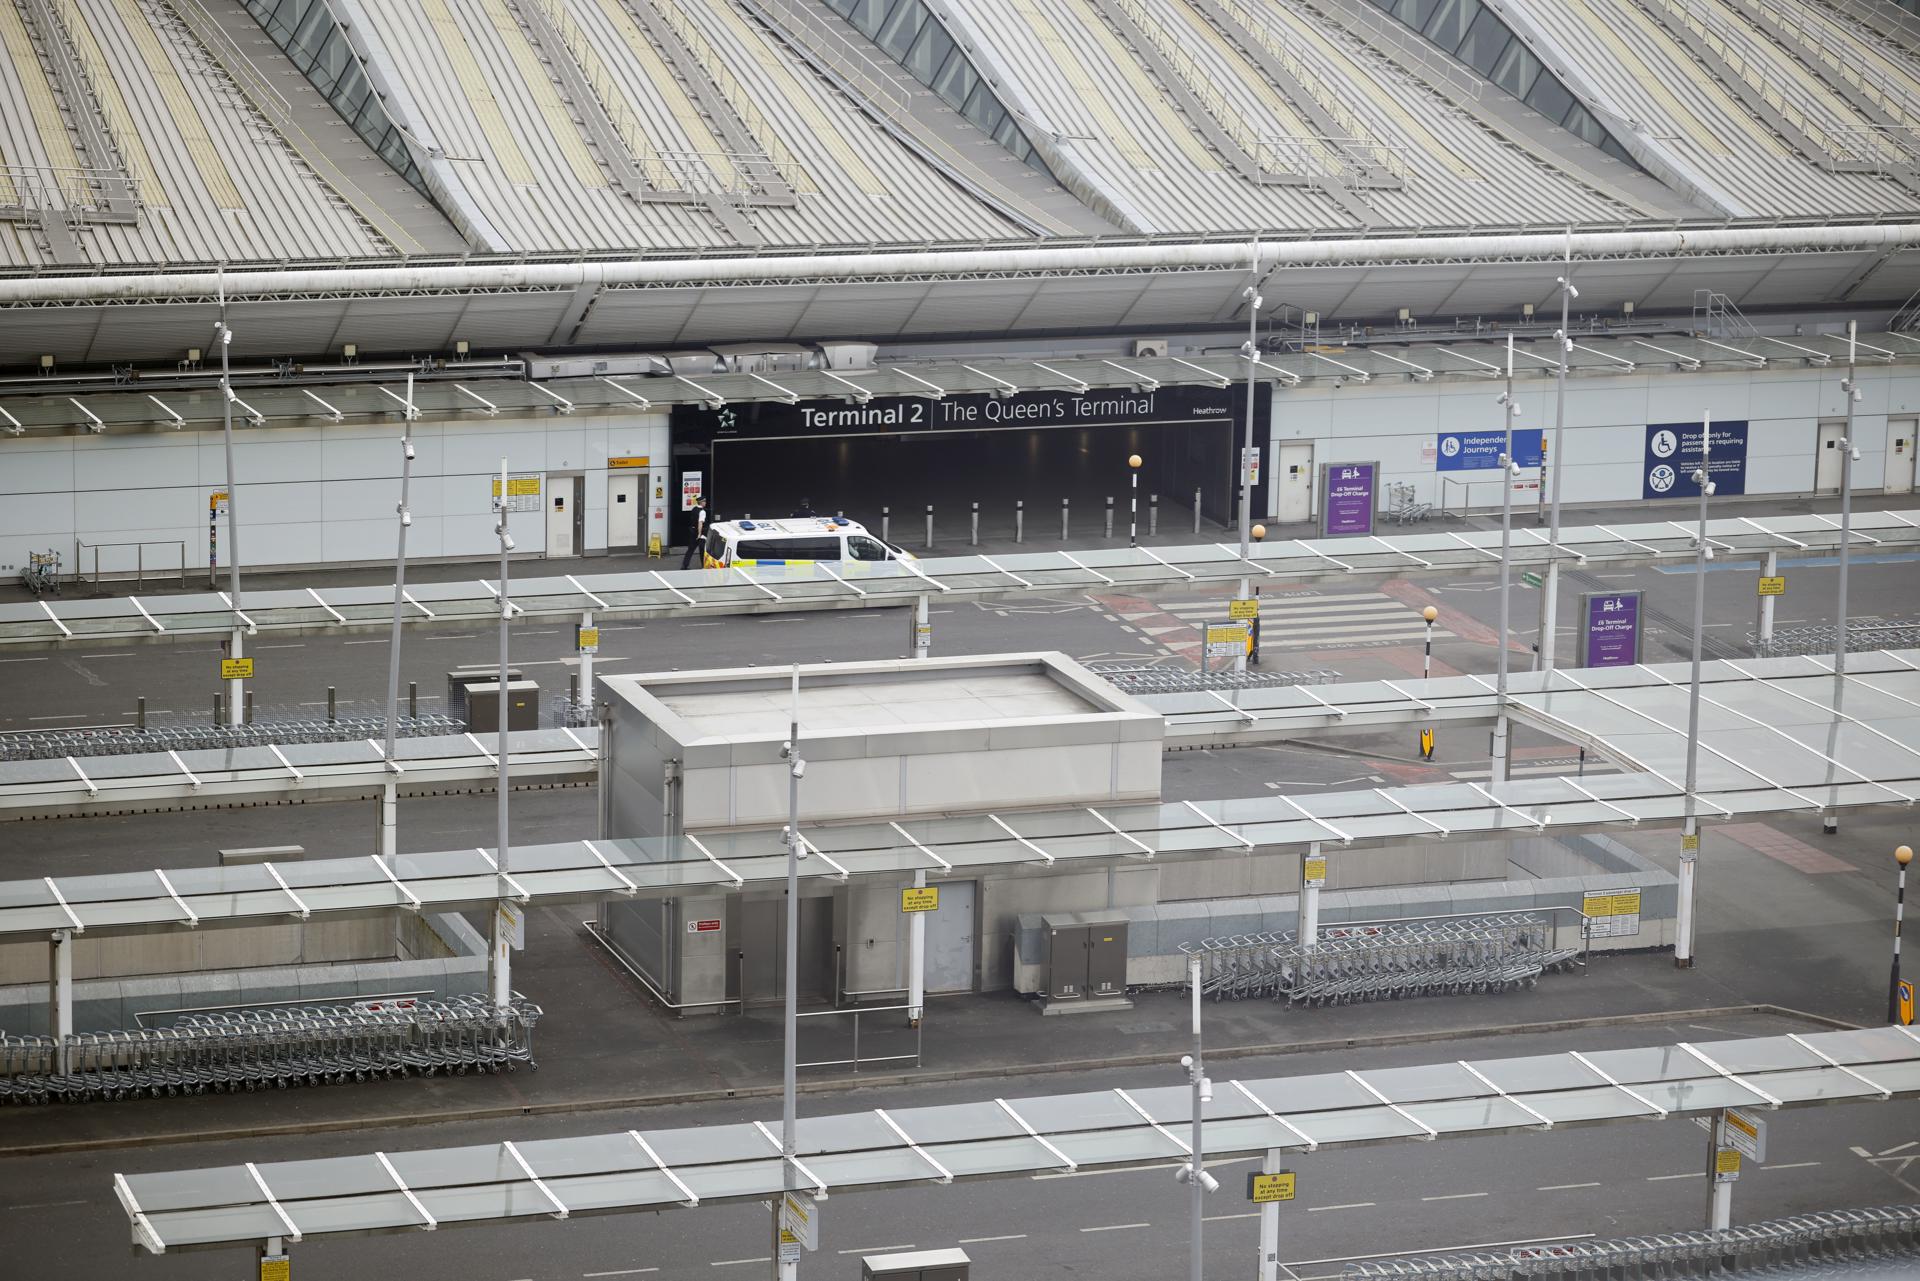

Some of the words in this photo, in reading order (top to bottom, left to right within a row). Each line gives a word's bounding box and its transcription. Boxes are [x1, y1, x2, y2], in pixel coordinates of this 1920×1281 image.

[802, 404, 903, 427] Terminal
[910, 404, 923, 423] 2
[941, 402, 978, 422] The
[985, 398, 1064, 423] Queen's
[1072, 394, 1154, 417] Terminal
[1193, 407, 1226, 415] Heathrow
[1463, 446, 1498, 454] Journeys
